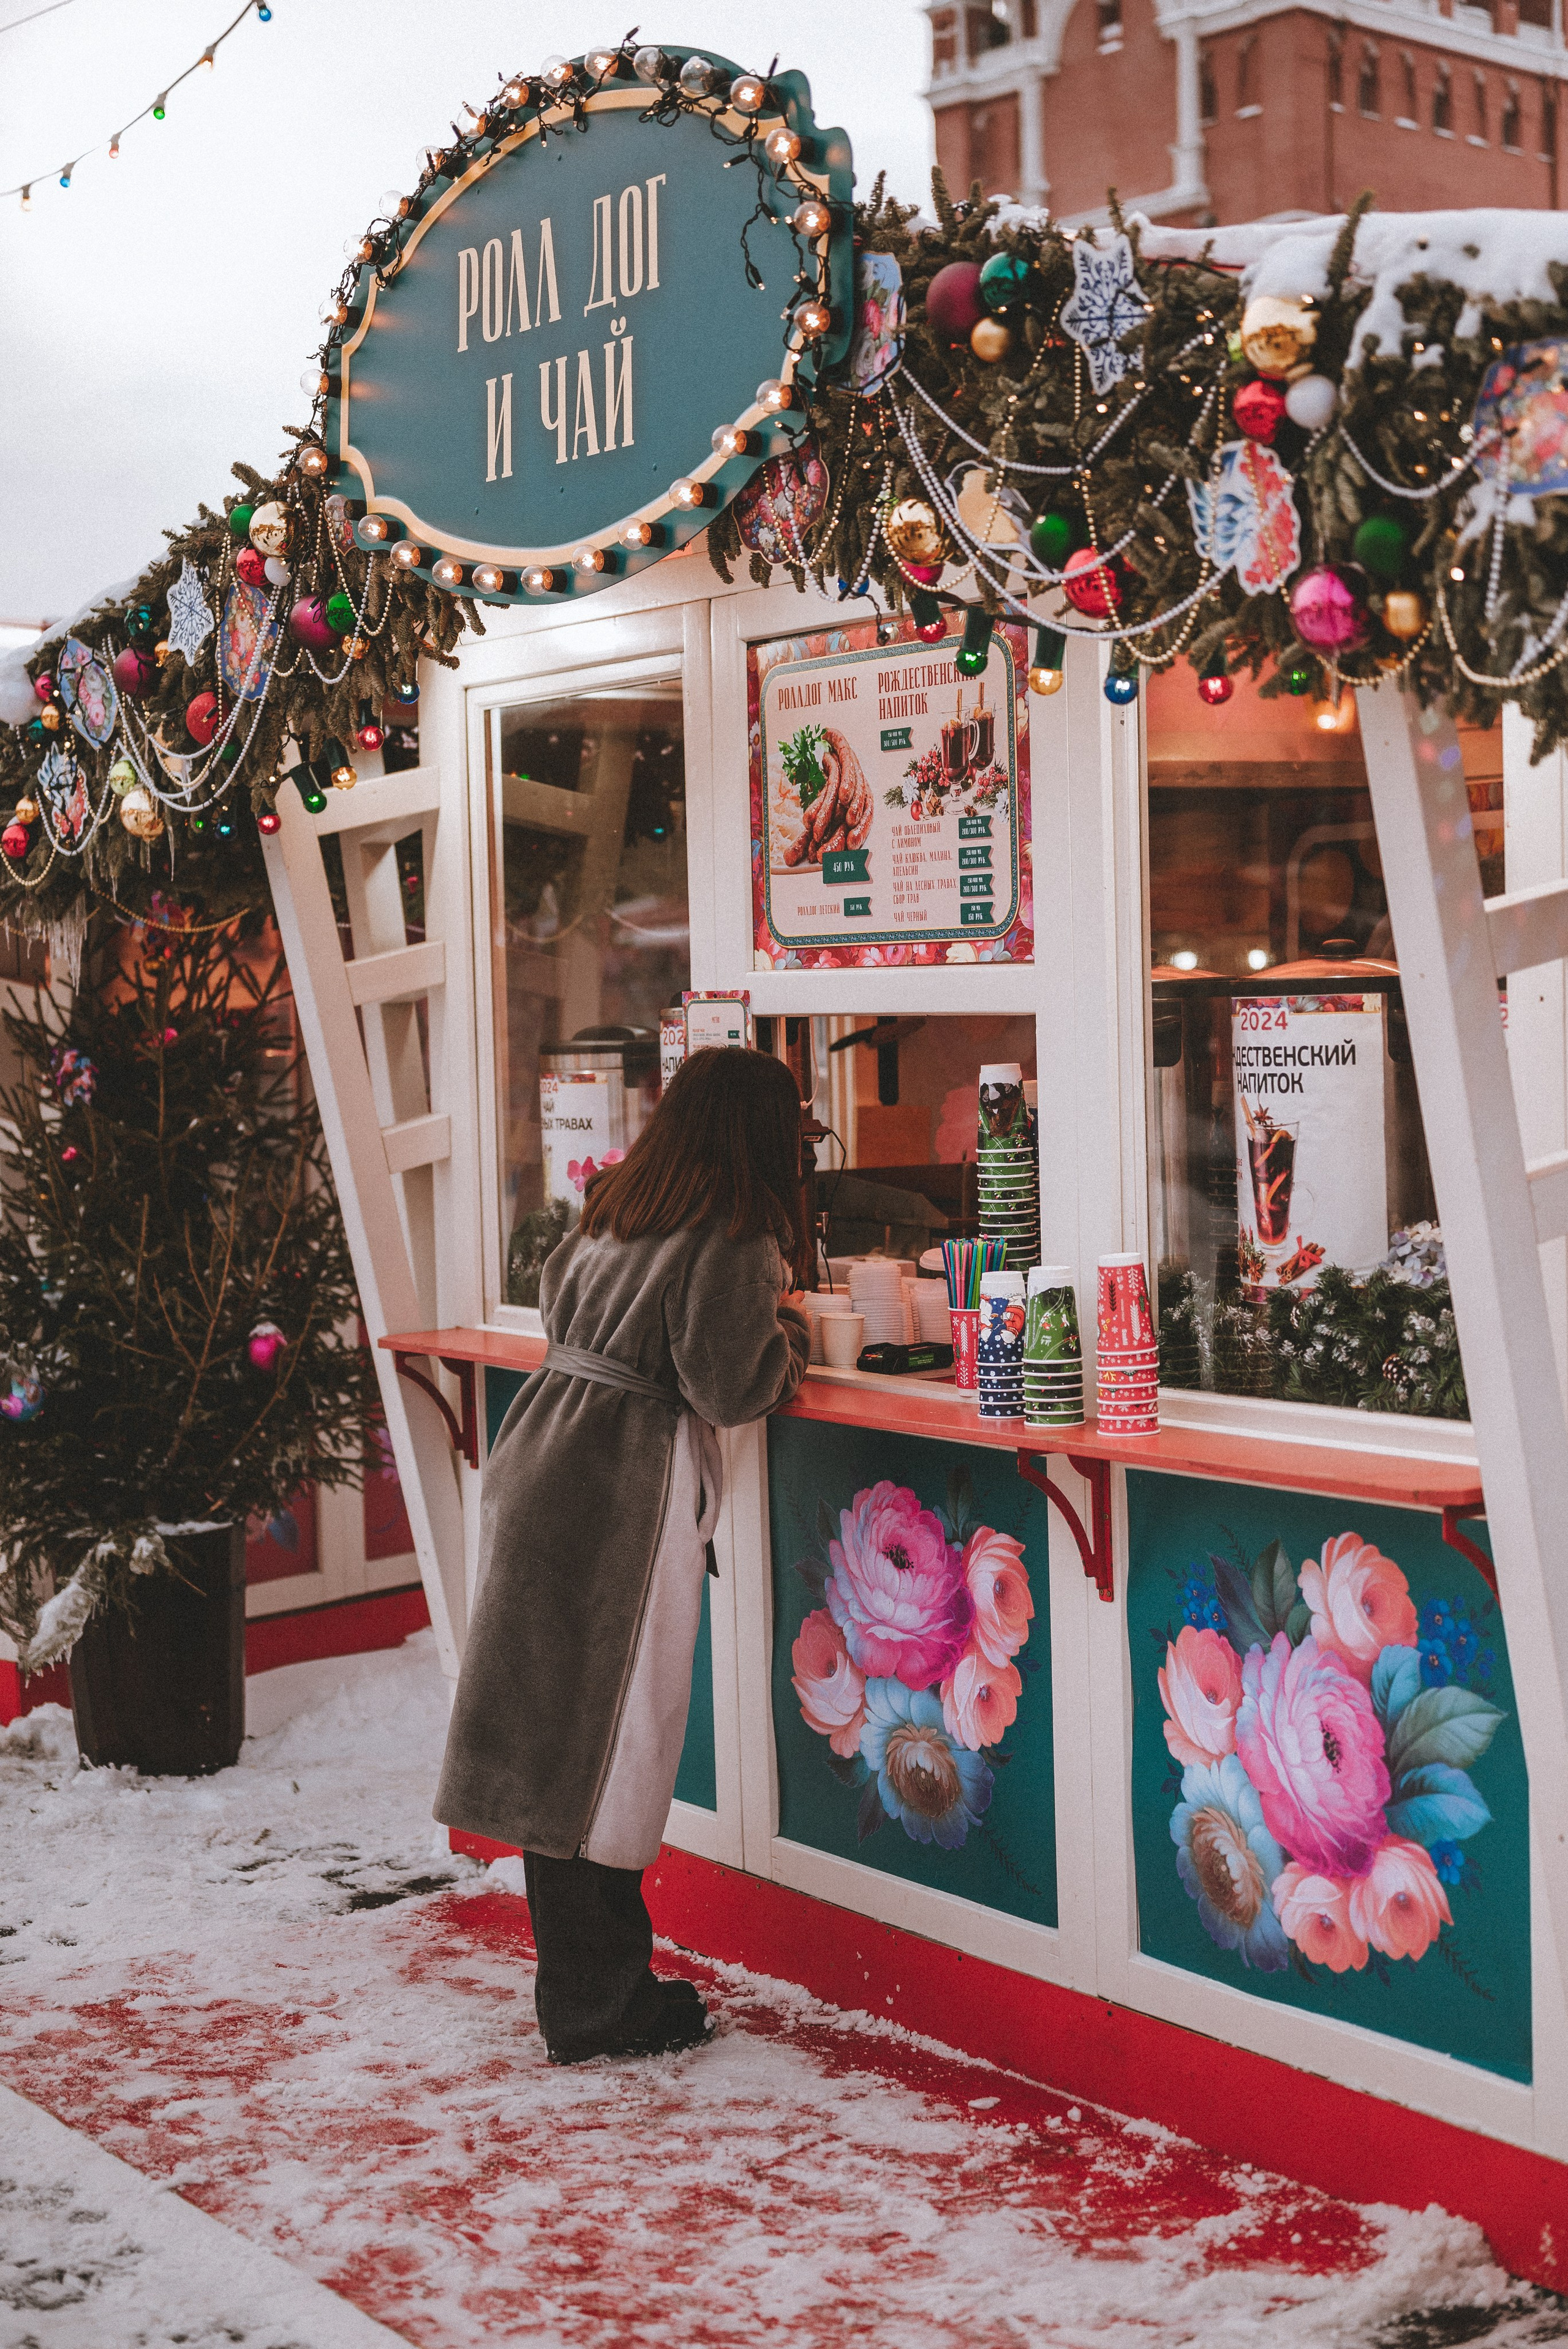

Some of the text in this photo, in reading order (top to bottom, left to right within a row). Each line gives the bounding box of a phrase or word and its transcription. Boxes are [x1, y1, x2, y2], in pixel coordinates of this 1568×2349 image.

[458, 173, 667, 353] РОЛЛ ДОГ
[485, 315, 635, 483] И ЧАЙ
[878, 661, 977, 694] РОЖДЕСТВЕНСК
[778, 676, 858, 711] РОЛЛДОГ МАКС
[878, 692, 929, 720] НАПИТОК
[891, 821, 941, 836] ЧАЙ ОБЛЕПИХОВЫЙ
[892, 837, 921, 849] С ЛИМОНОМ
[892, 852, 903, 864] ЧАЙ
[962, 857, 977, 865] 200/300
[833, 861, 856, 873] 450 РУБ.
[892, 865, 918, 877] АПЕЛЬСИН
[893, 880, 903, 892] ЧАЙ
[906, 881, 913, 891] НА
[914, 880, 935, 891] ЛЕСНЫХ
[893, 893, 919, 905] СБОР ТРАВ
[797, 902, 840, 916] РОЛЛДОГ ДЕТСКИЙ
[894, 910, 927, 922] ЧАЙ ЧЕРНЫЙ
[1241, 1011, 1288, 1030] 2024
[1237, 1072, 1304, 1093] НАПИТОК
[555, 1118, 594, 1131] ТРАВАХ
